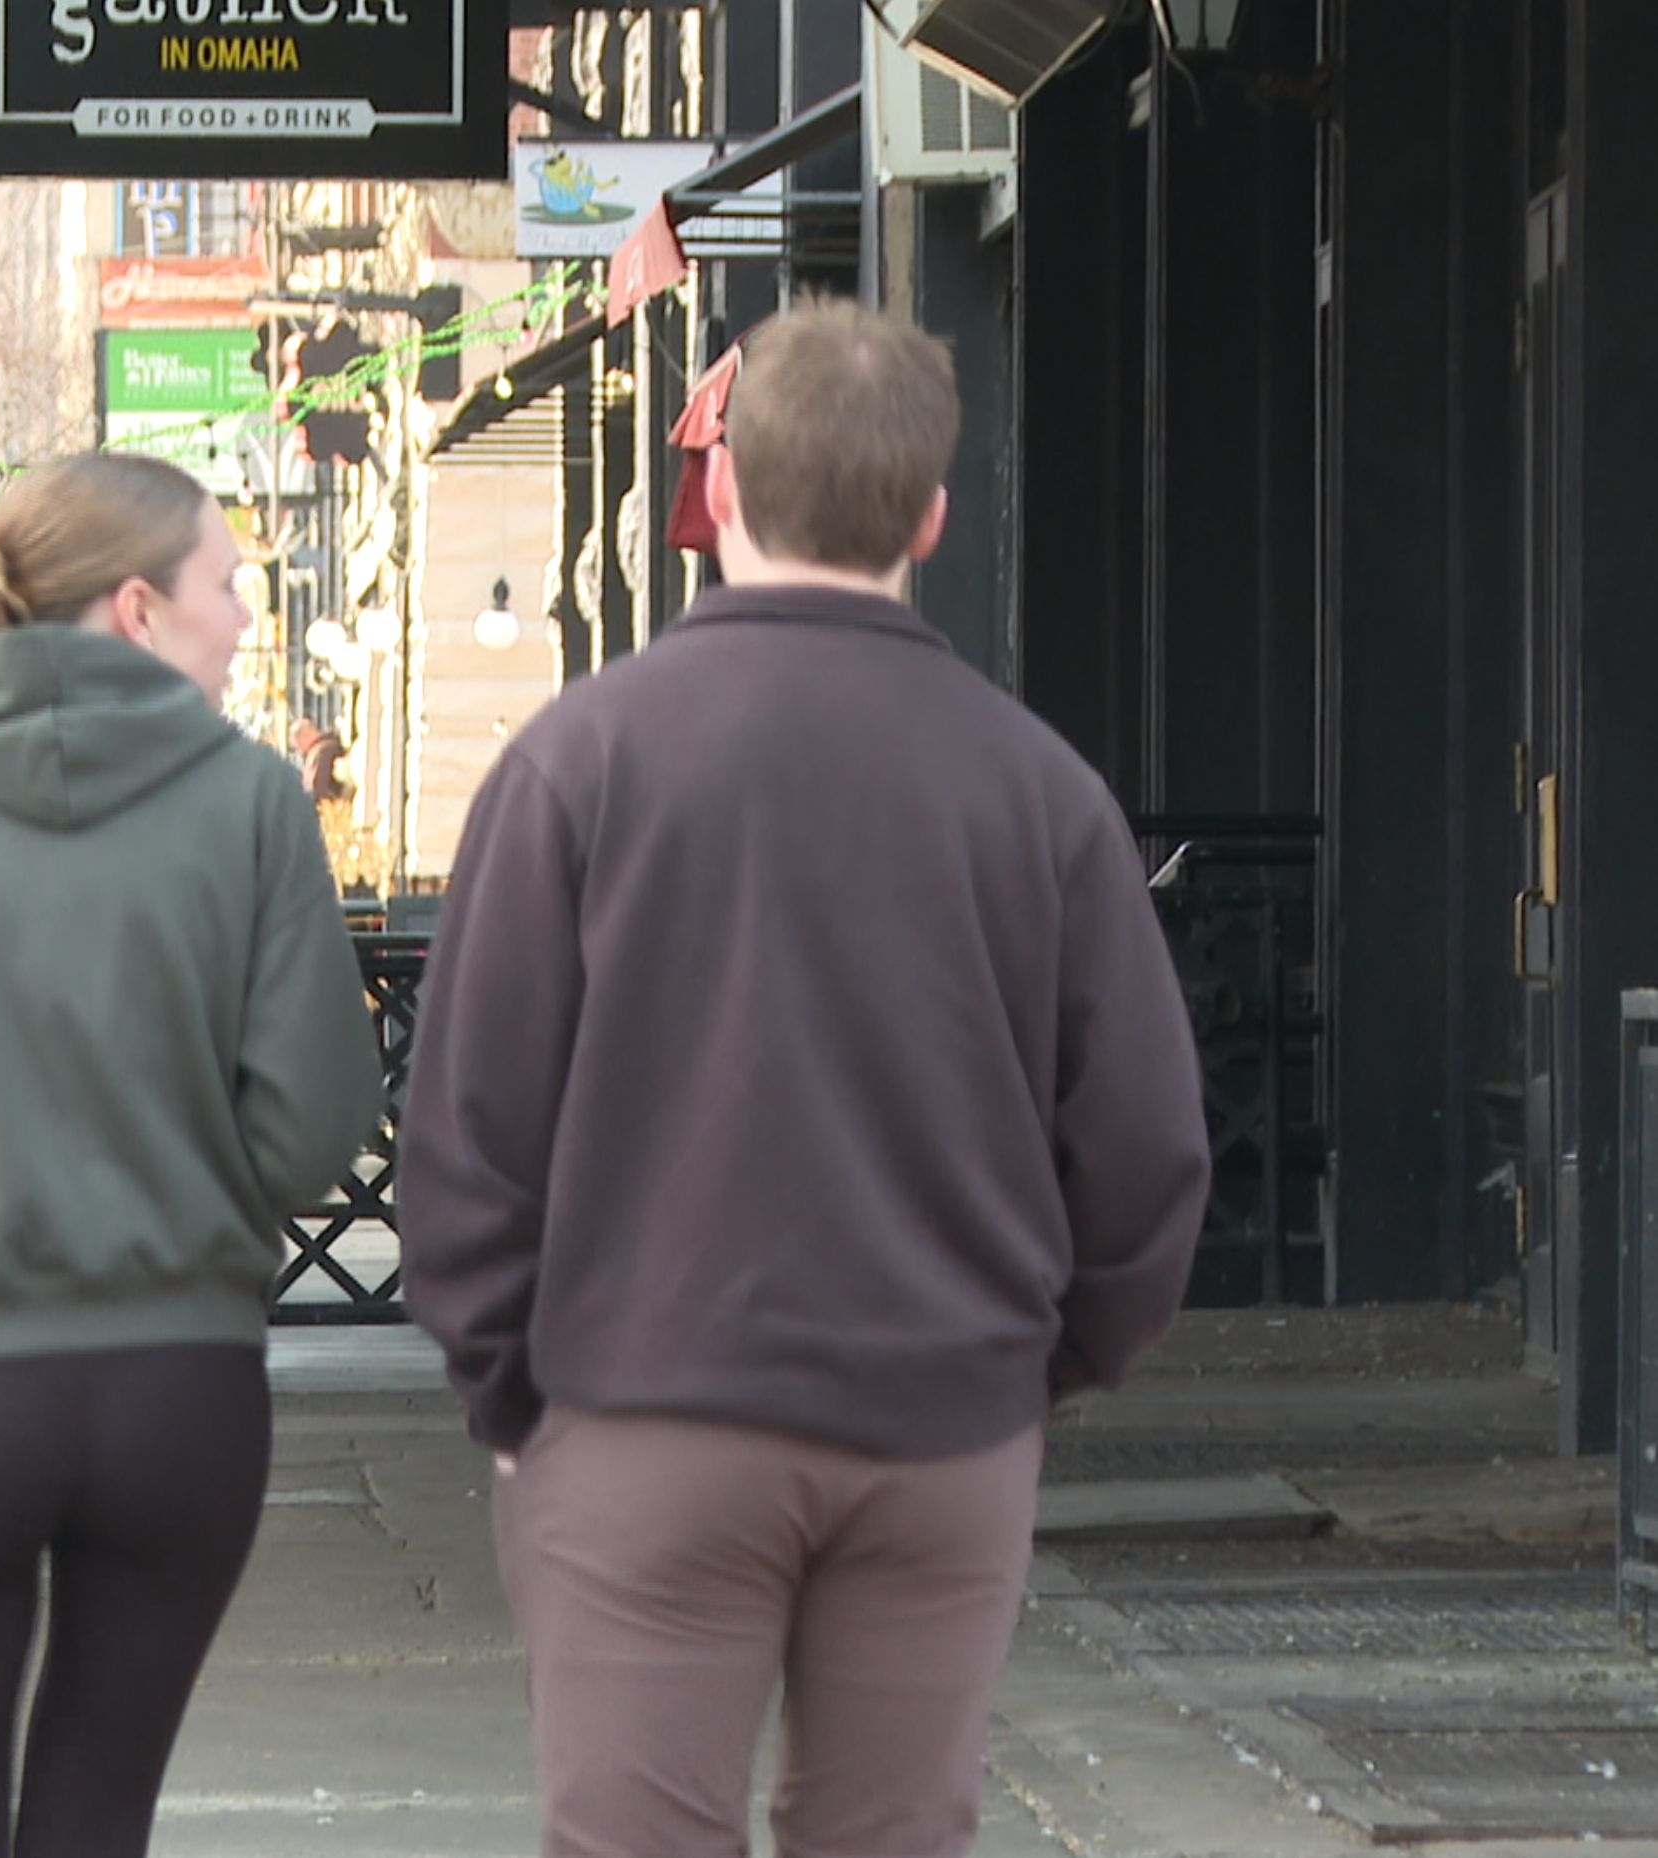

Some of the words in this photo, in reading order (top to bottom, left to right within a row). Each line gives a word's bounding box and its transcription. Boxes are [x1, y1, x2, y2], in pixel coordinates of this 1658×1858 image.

[160, 37, 190, 69] IN
[197, 37, 299, 70] OMAHA
[97, 108, 150, 128] FOR
